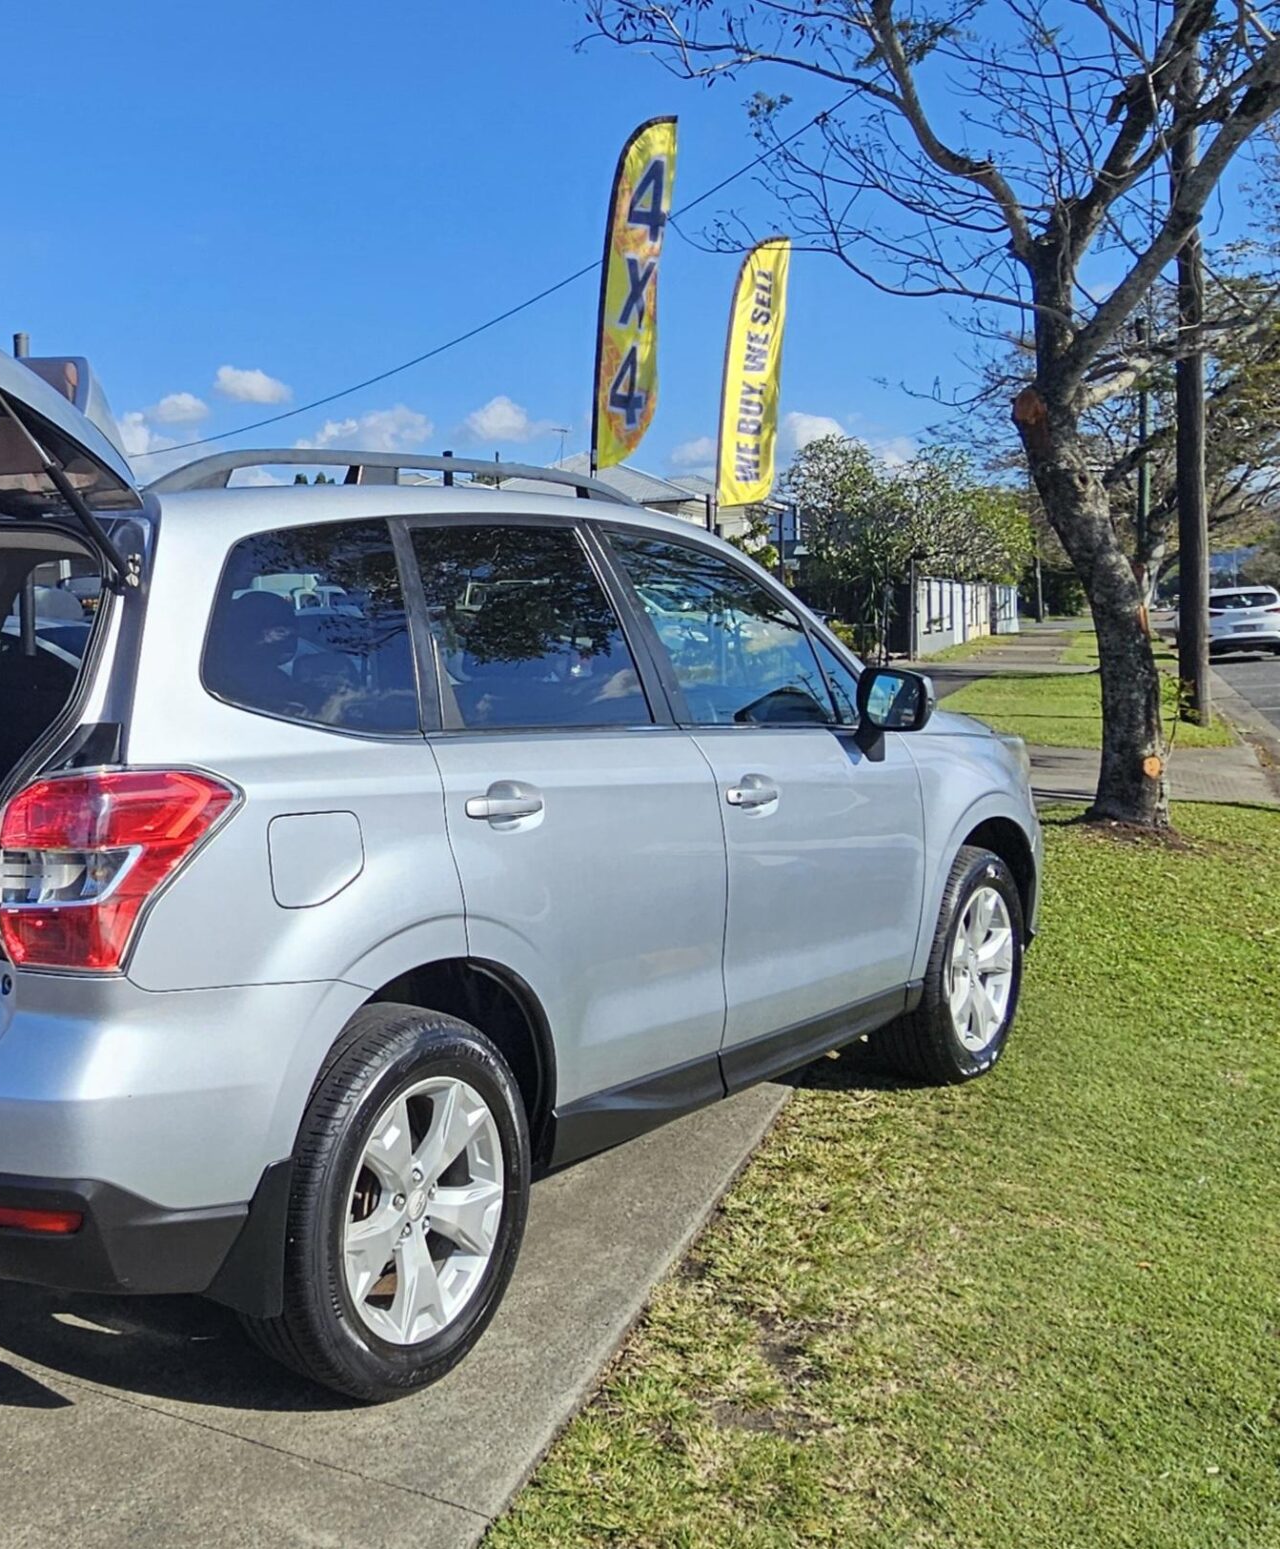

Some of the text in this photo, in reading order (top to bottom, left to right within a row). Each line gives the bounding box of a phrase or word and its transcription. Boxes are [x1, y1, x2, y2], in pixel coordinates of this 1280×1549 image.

[751, 270, 773, 325] SELL
[744, 331, 769, 371] WE
[735, 441, 760, 482] WE
